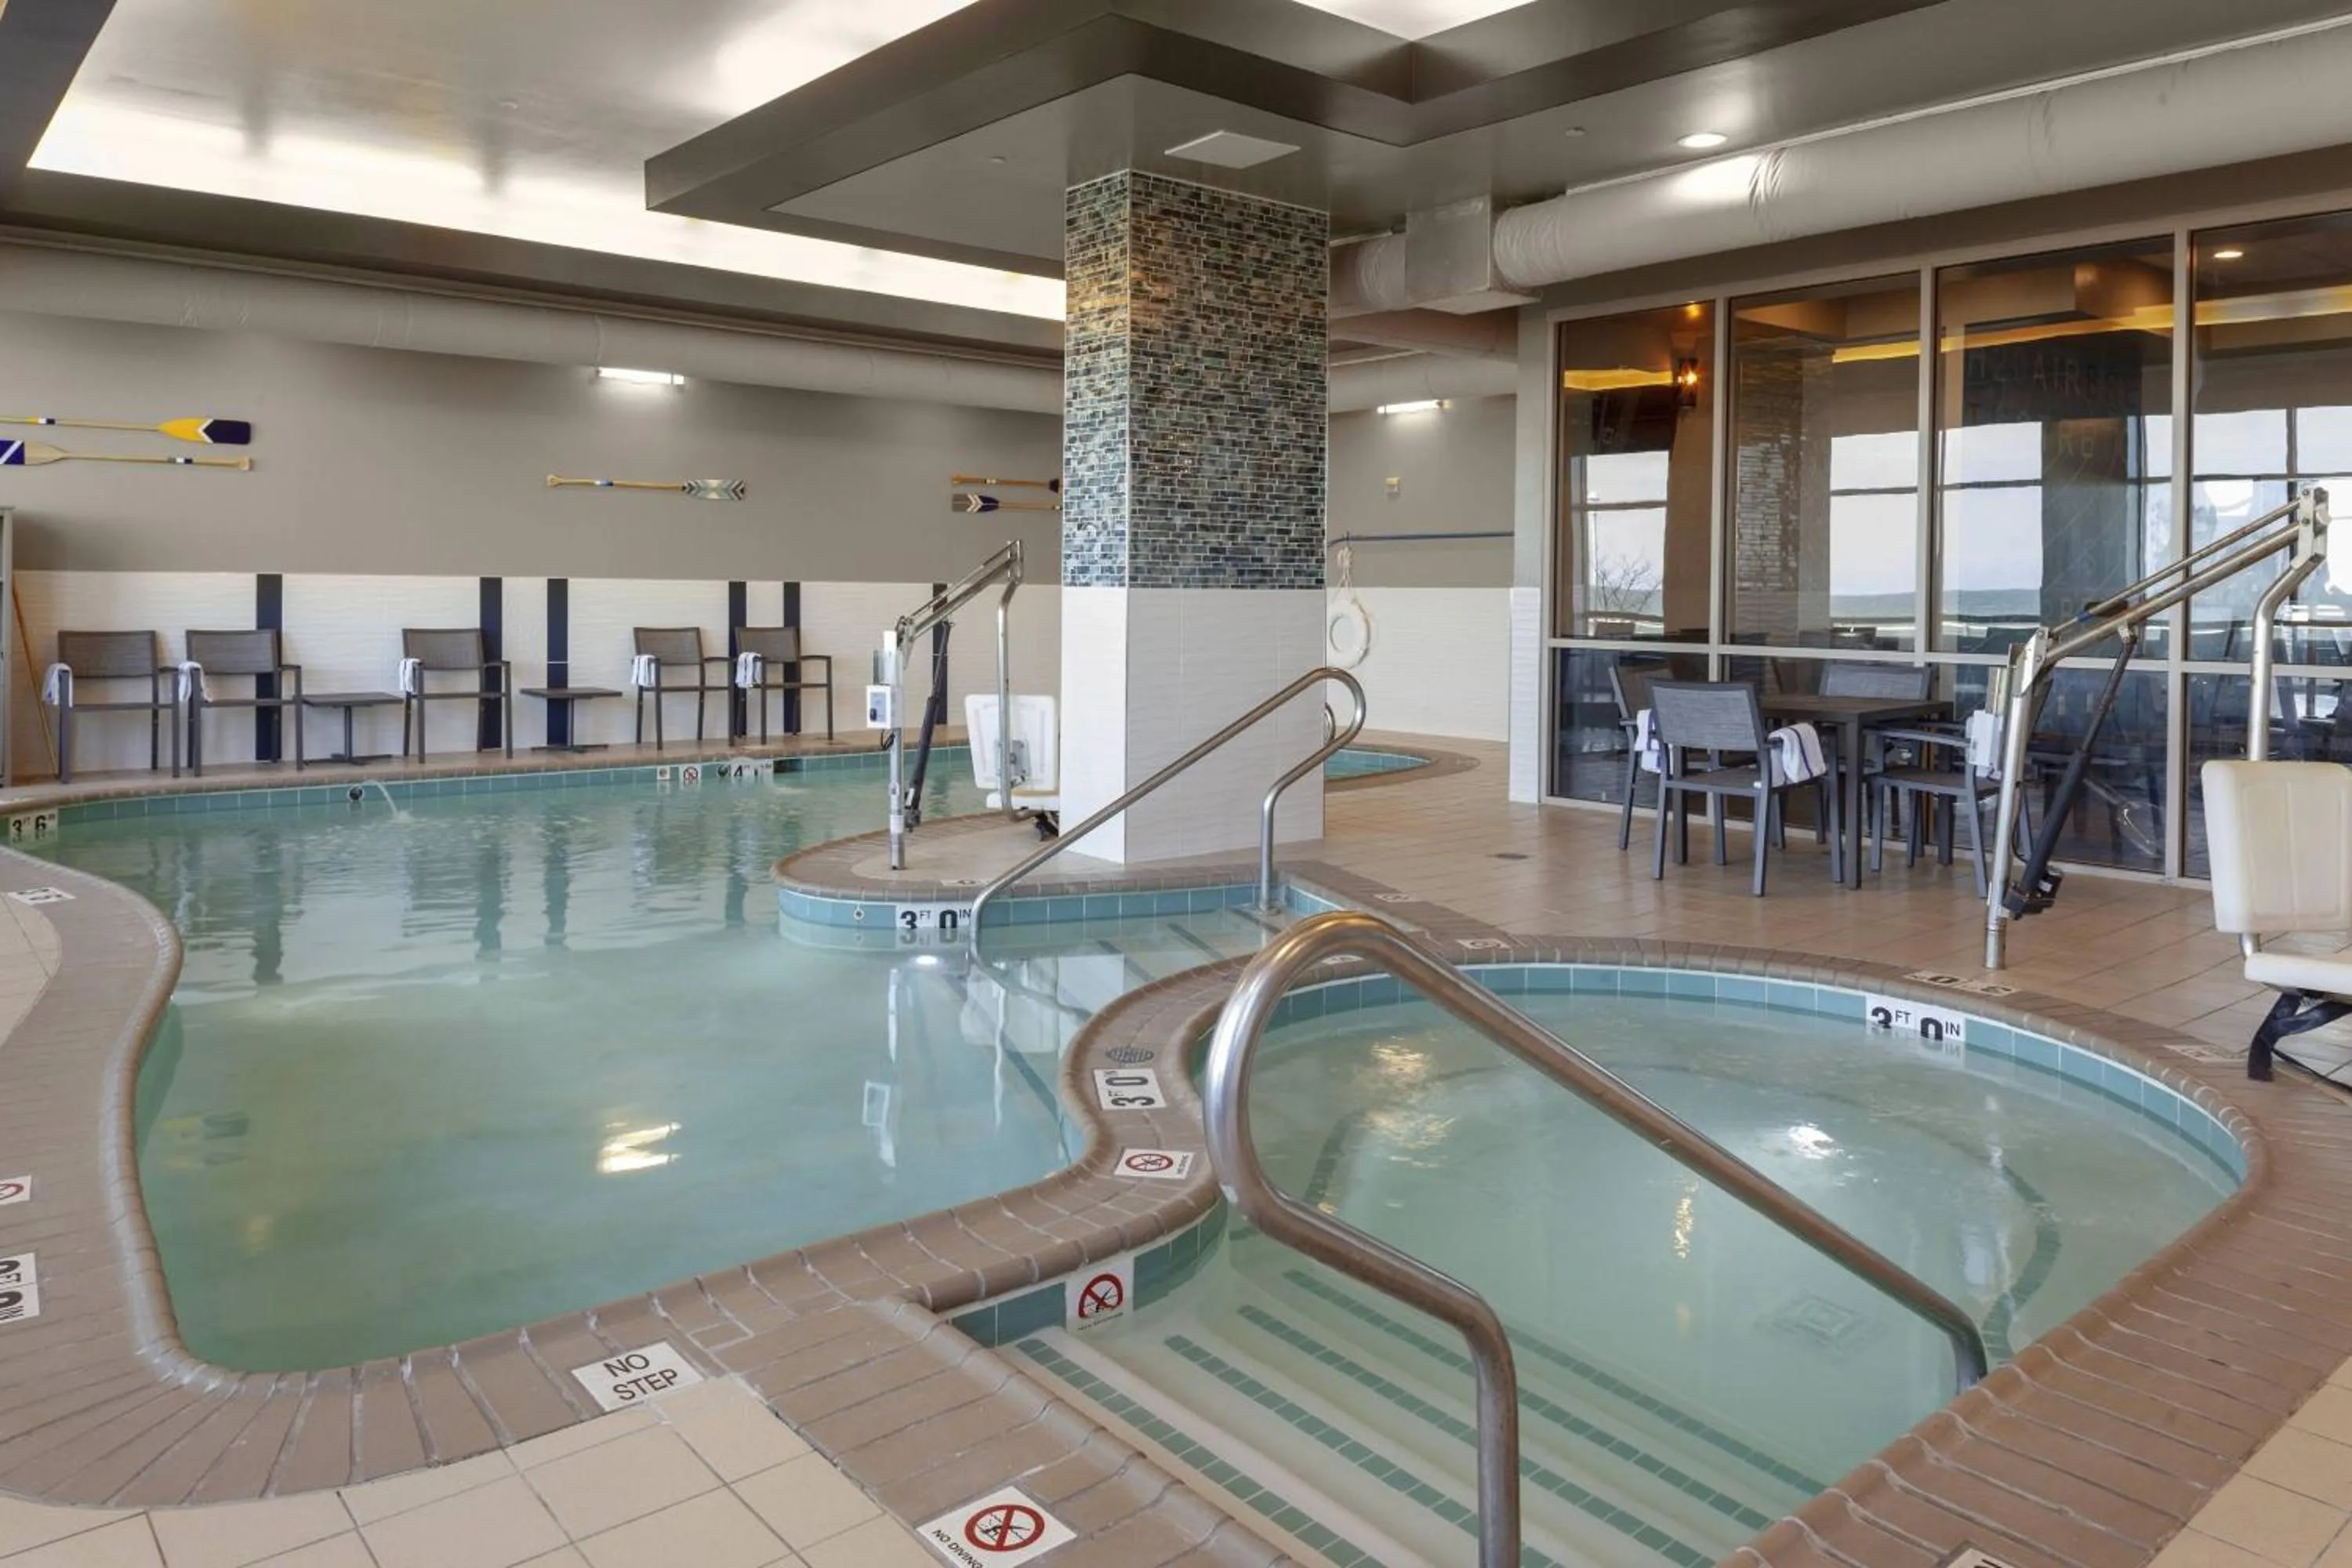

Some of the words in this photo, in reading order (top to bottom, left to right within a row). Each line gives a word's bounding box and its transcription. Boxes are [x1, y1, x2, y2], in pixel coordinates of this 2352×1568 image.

[900, 910, 917, 929] 3
[919, 910, 931, 920] FT
[959, 909, 972, 920] IN
[1895, 1010, 1911, 1025] FT
[1945, 1022, 1961, 1036] IN
[1111, 1097, 1155, 1106] 3
[603, 1354, 650, 1377] NO
[612, 1368, 678, 1401] STEP
[931, 1530, 951, 1543] NO
